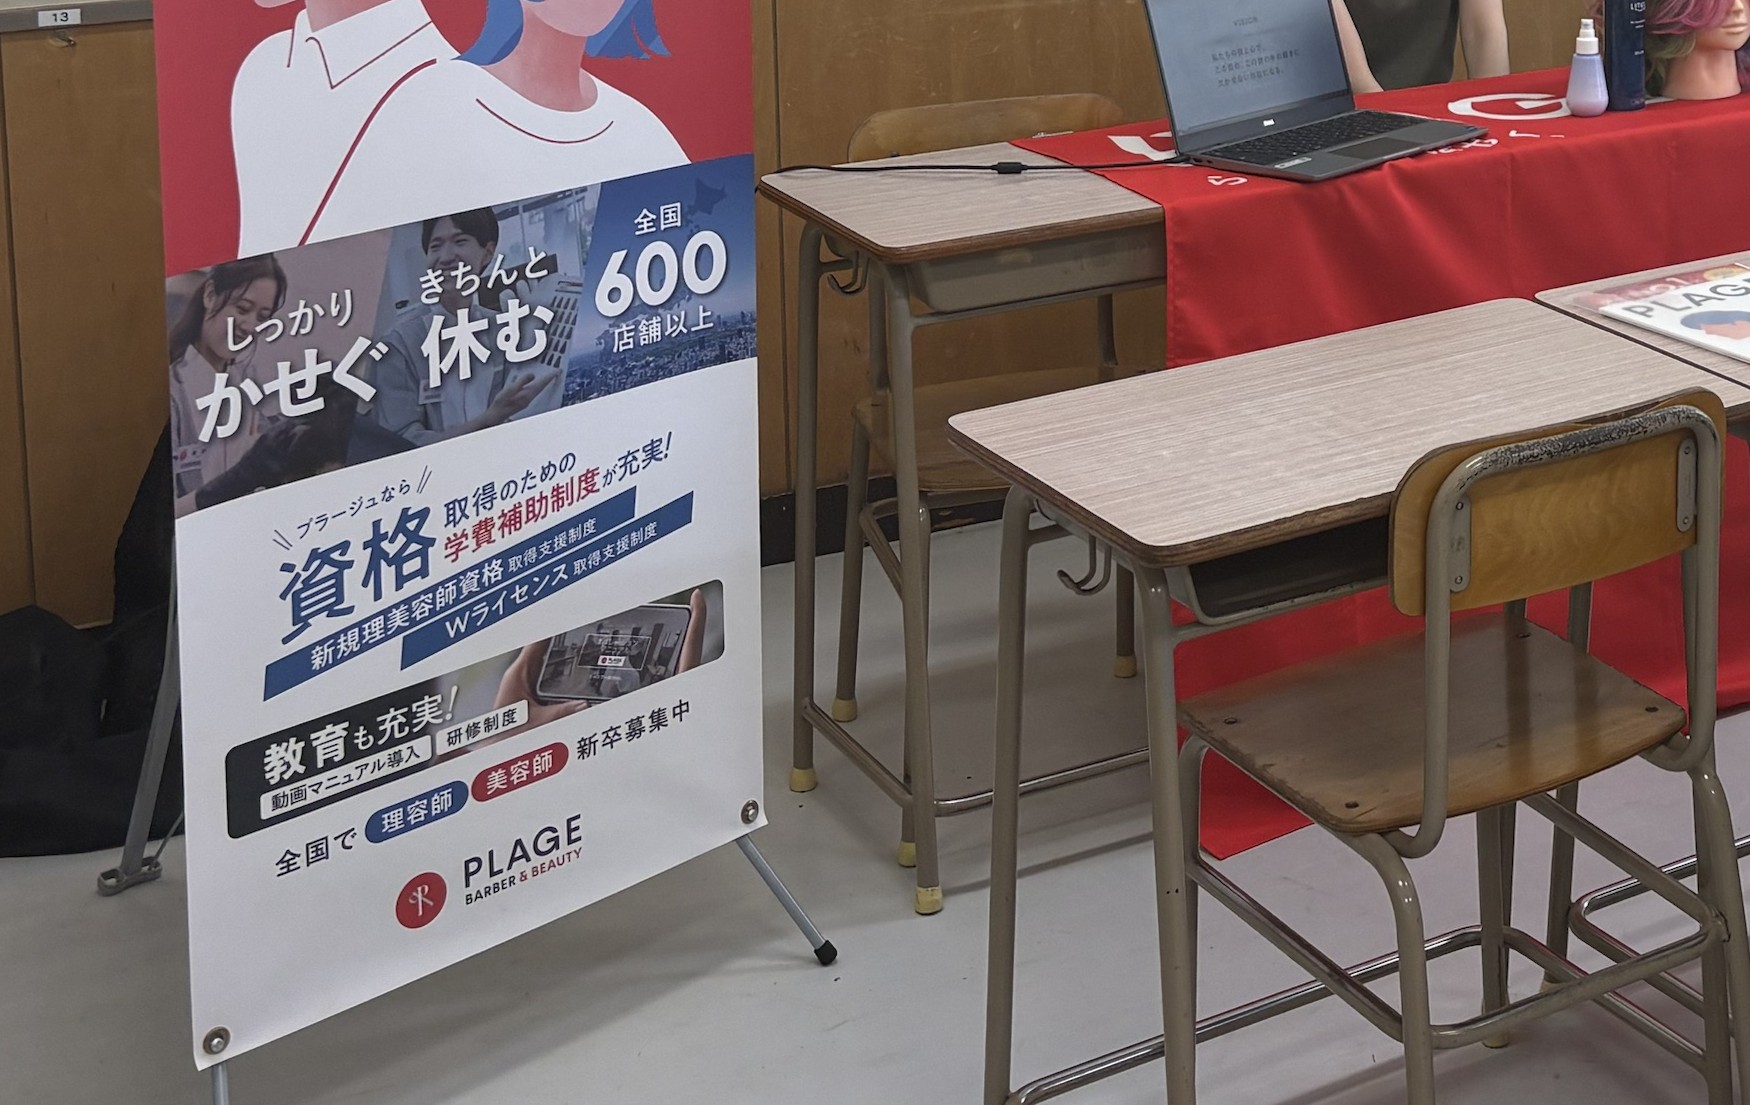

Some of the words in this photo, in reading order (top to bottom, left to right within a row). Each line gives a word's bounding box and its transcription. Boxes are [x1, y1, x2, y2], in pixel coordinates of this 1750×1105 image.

[52, 11, 69, 23] 13
[634, 202, 682, 237] 全国
[419, 247, 549, 307] きちんと
[594, 229, 727, 319] 600
[227, 288, 353, 353] しっかり
[421, 298, 556, 389] 休む
[612, 304, 715, 355] 店舗以上
[195, 336, 390, 444] かせぐ
[297, 478, 411, 540] プラージュなら
[443, 452, 577, 530] 取得のための
[443, 431, 673, 563] 学費補助制度が充実!
[278, 506, 437, 646] 資格
[309, 557, 504, 671] 新規理美容師資格
[507, 517, 598, 574] 取得支援制度
[445, 563, 569, 639] Wライセンス
[572, 520, 658, 577] 取得支援制度
[262, 686, 459, 786] 教育も充実!
[271, 744, 421, 813] 動画マニュアル導入
[446, 706, 519, 748] 研修制度
[275, 827, 357, 878] 全国で
[382, 787, 454, 835] 理容師
[486, 749, 553, 796] 美容師
[576, 698, 692, 762] 新卒募集中
[462, 813, 583, 889] PLAGE
[465, 876, 517, 906] BARBER
[530, 846, 583, 880] BEAUTY
